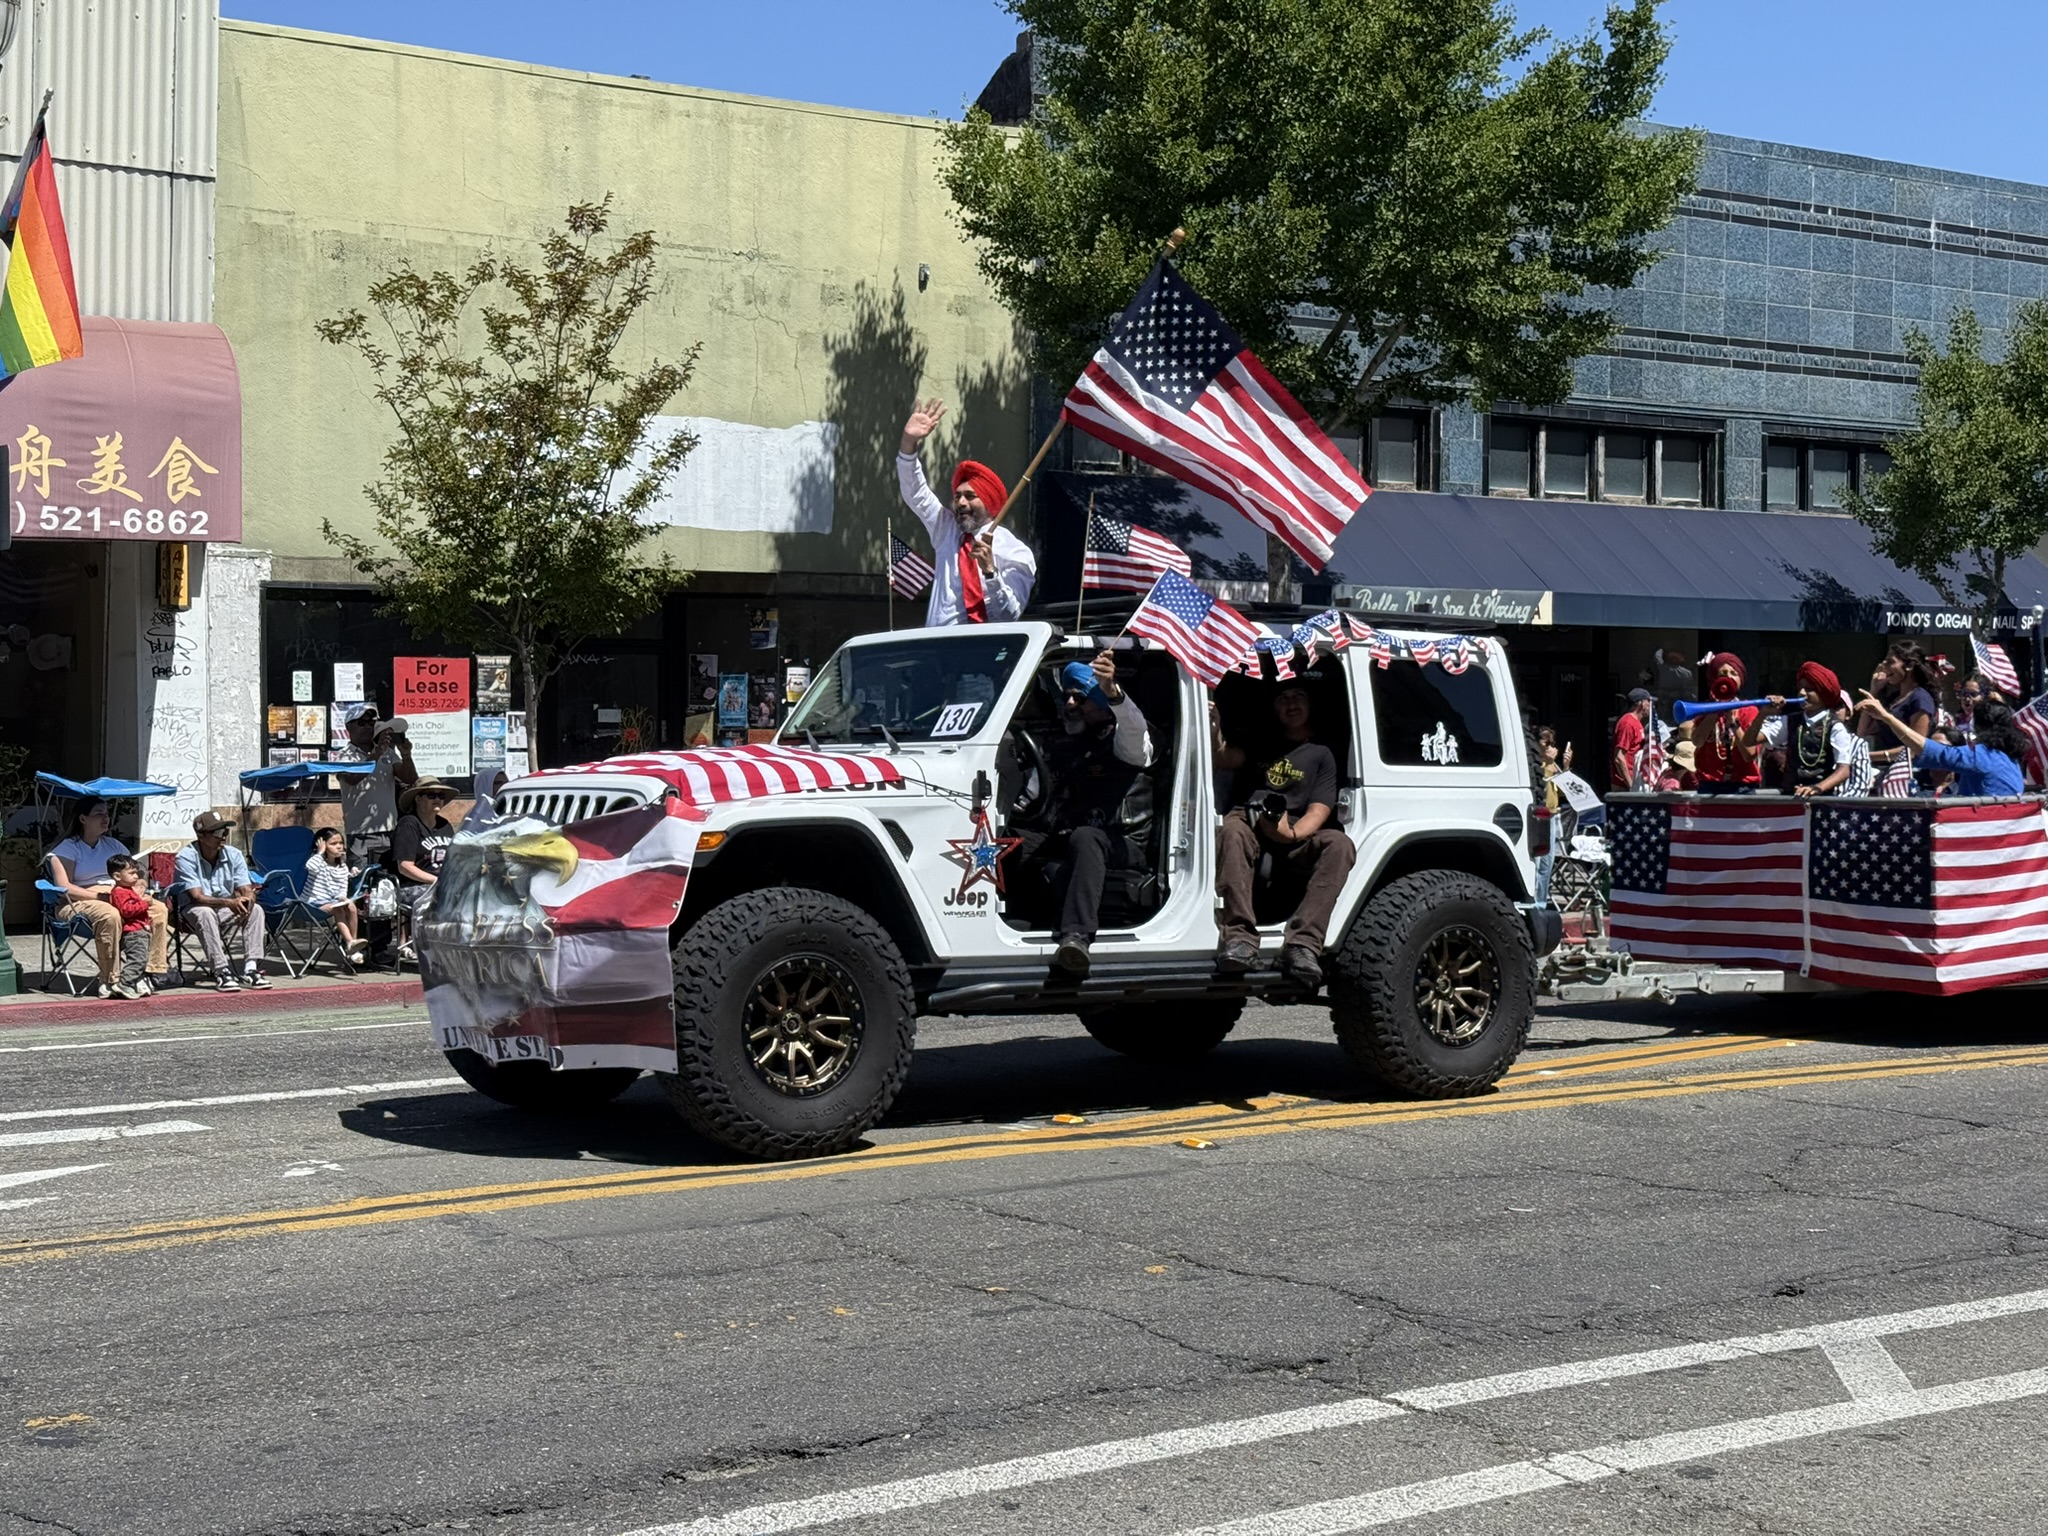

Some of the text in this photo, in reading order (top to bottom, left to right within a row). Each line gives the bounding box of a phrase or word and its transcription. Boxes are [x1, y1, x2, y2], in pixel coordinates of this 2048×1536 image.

[40, 505, 209, 535] 521-6862
[1469, 592, 1481, 618] &
[1993, 616, 2018, 630] NAIL
[2021, 615, 2034, 631] SP
[416, 660, 448, 676] For
[405, 678, 459, 694] Lease
[398, 698, 466, 709] 415.395.7262
[935, 707, 977, 733] 130
[943, 887, 988, 909] Jeep
